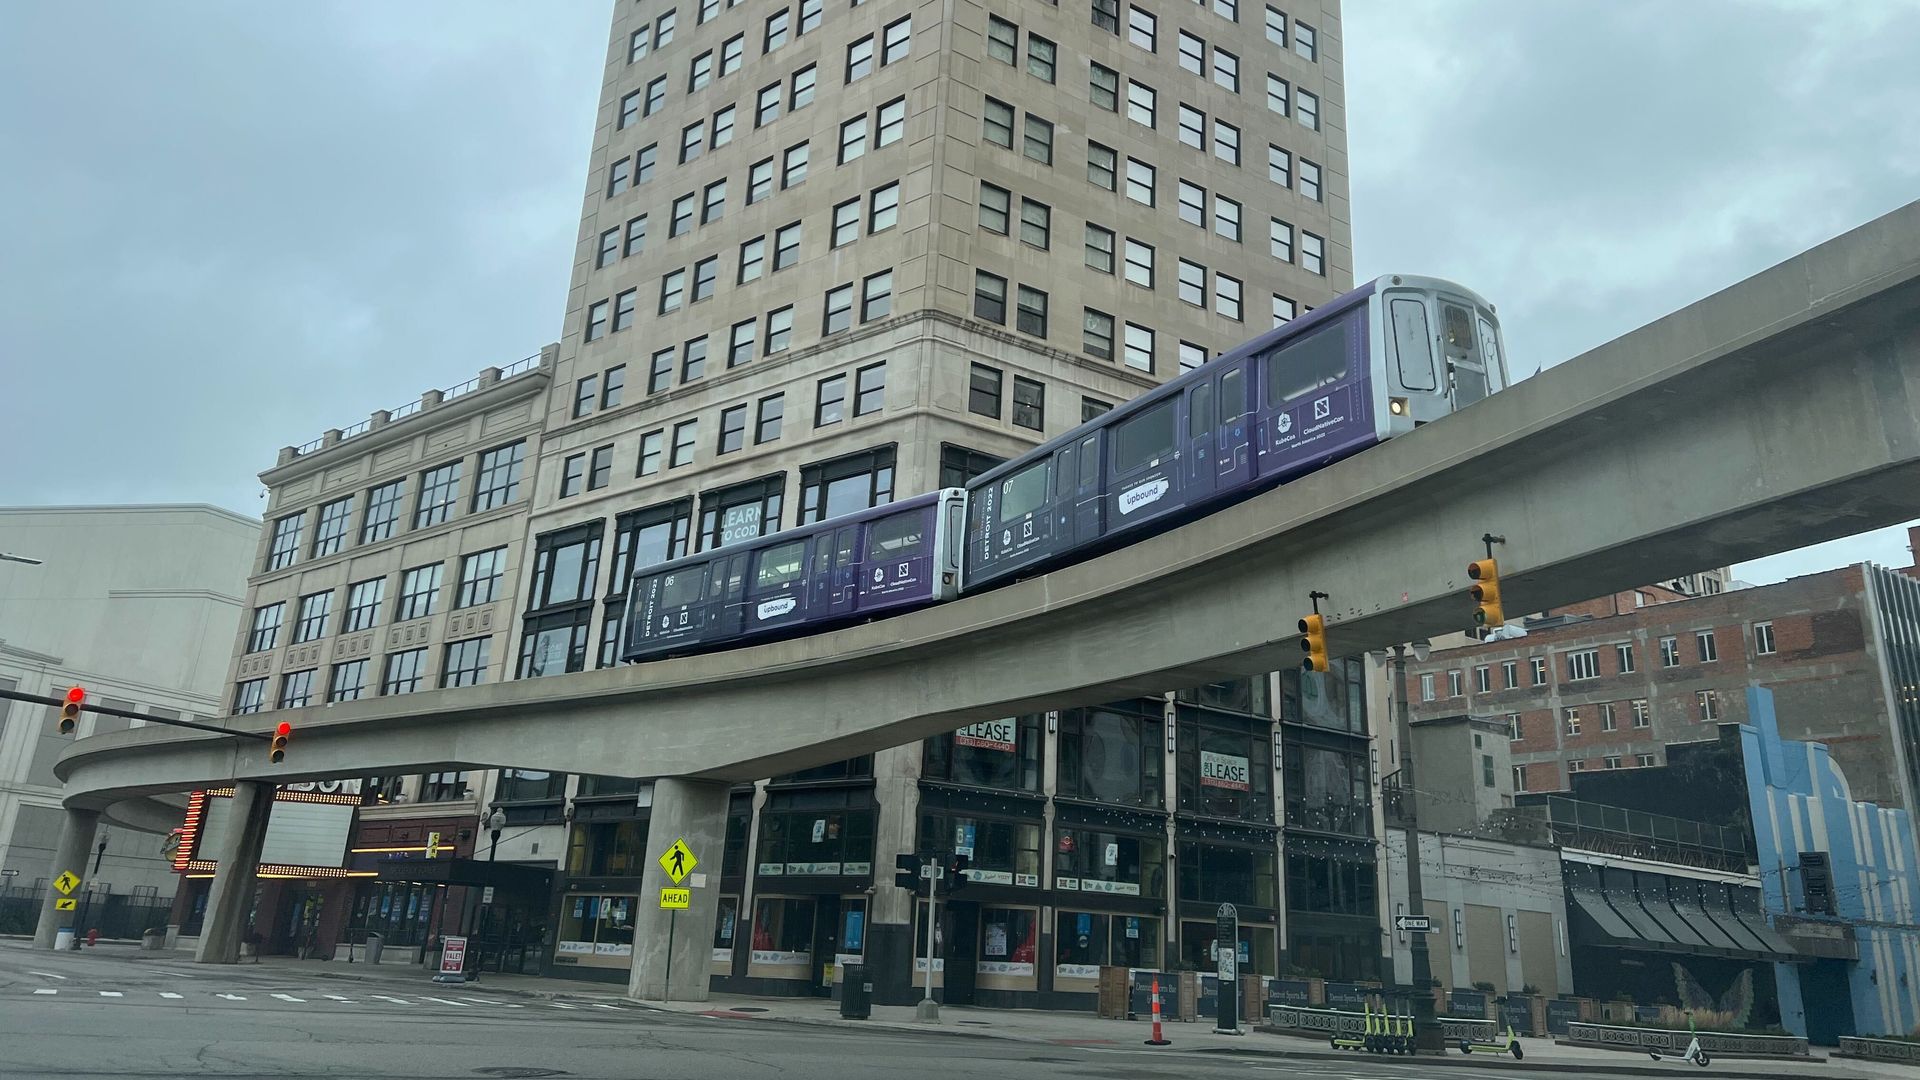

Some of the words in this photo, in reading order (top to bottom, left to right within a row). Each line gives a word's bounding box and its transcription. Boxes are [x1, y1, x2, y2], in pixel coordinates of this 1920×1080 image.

[1303, 415, 1344, 435] CloudNativeCon
[1275, 434, 1296, 446] KubeCon
[1003, 480, 1014, 494] 07
[734, 524, 760, 539] COD
[984, 515, 992, 560] DETROIT
[665, 575, 674, 587] 06
[645, 601, 654, 637] DETROIT
[967, 722, 1011, 742] LEASE
[1210, 762, 1245, 782] LEASE
[662, 893, 688, 903] AHEAD
[446, 951, 462, 961] VALET
[1270, 990, 1286, 999] Detroit
[1286, 990, 1299, 1000] Sports
